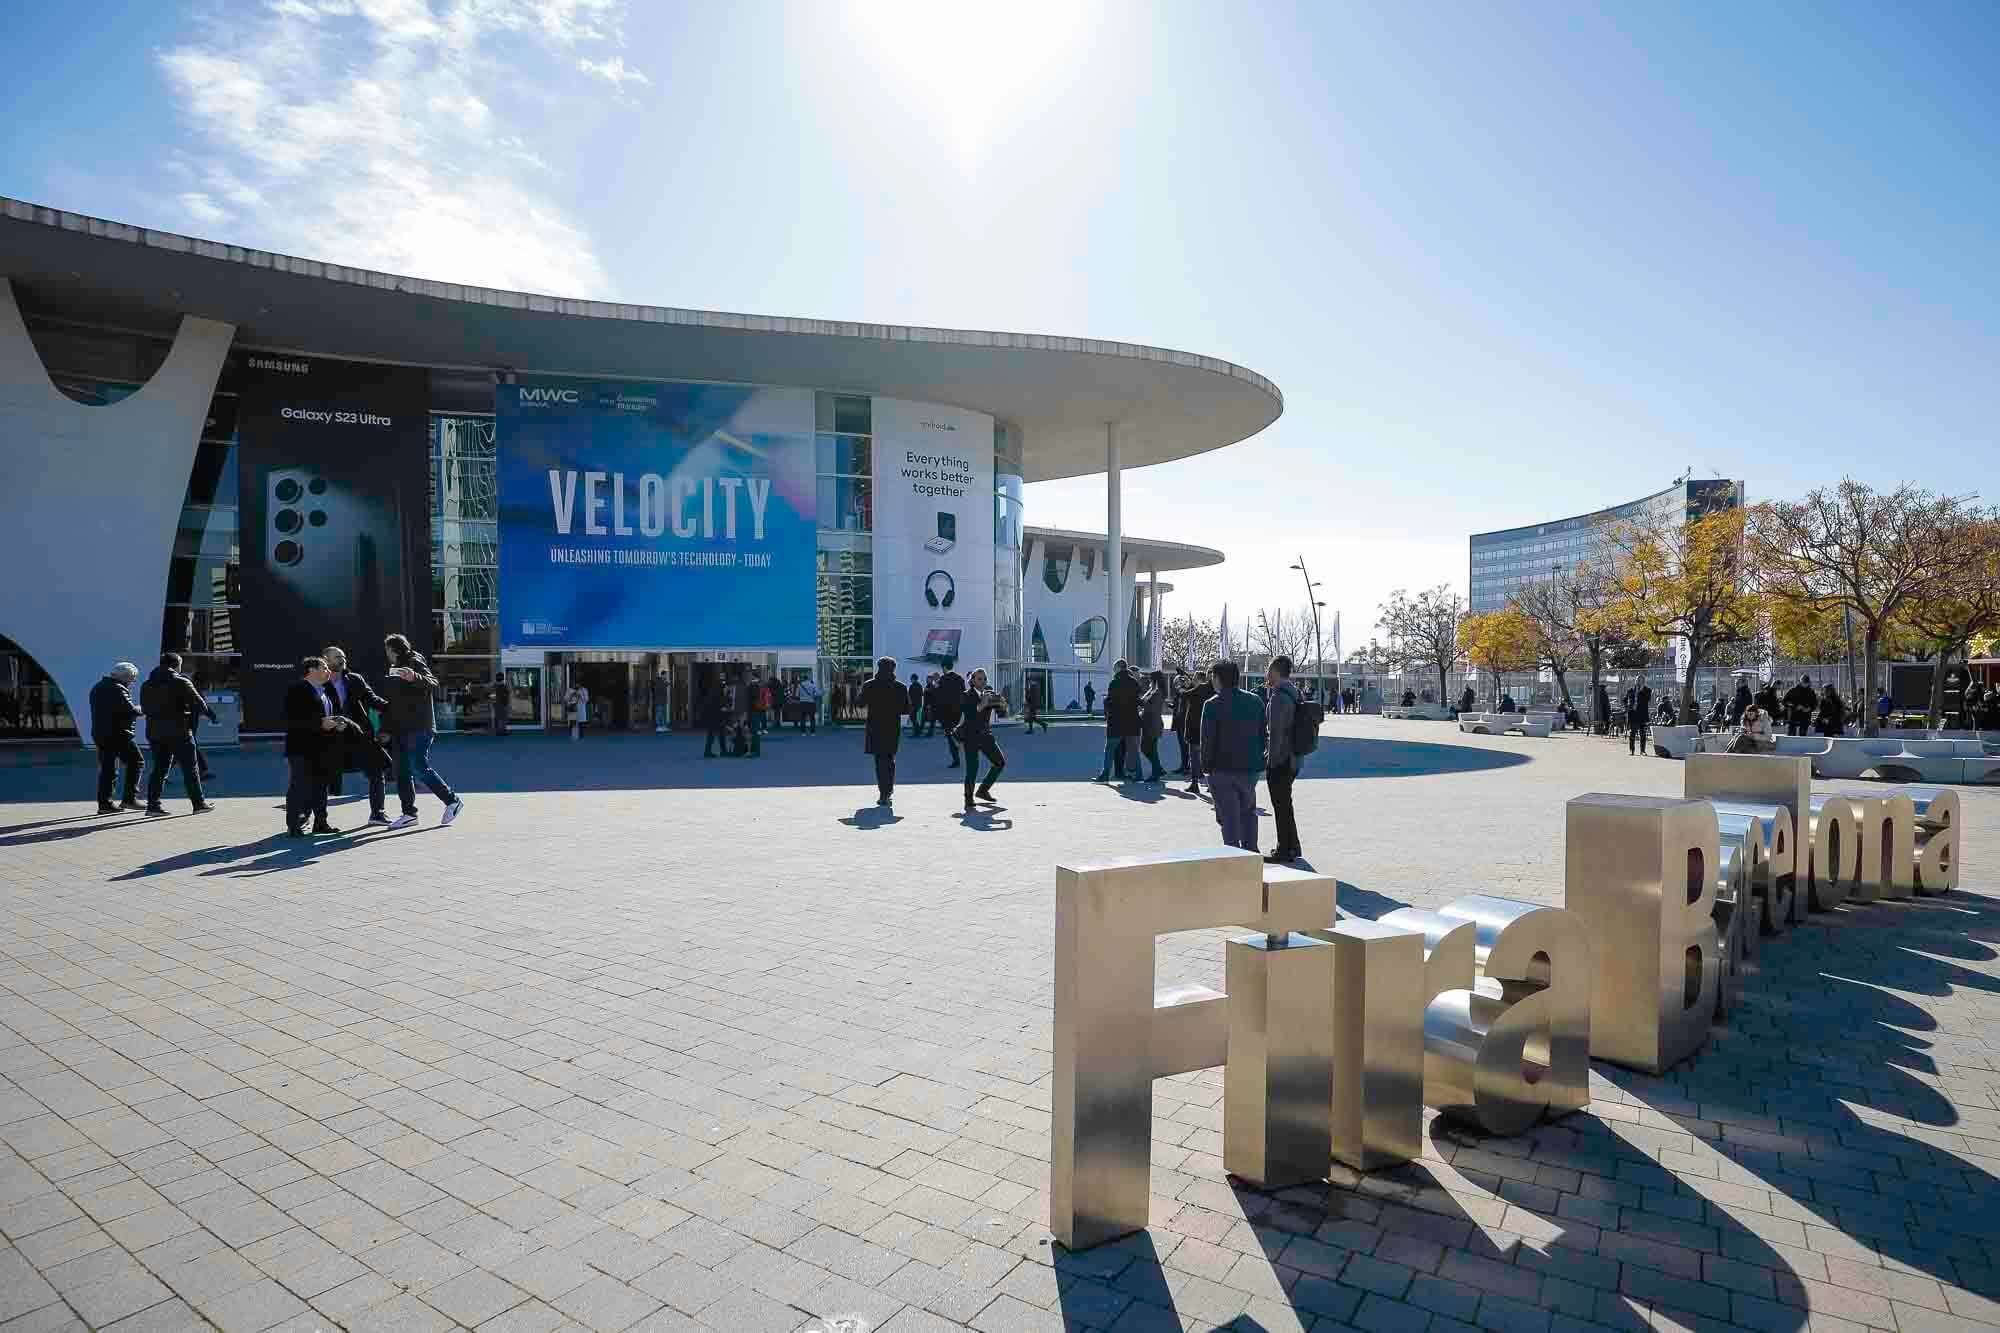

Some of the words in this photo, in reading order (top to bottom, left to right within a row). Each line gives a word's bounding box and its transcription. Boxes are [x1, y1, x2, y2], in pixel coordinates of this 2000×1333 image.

[248, 358, 309, 374] SAMSUNG
[519, 387, 579, 403] MWC
[281, 407, 332, 424] Galaxy
[335, 412, 357, 423] S23
[359, 413, 392, 426] Ultra
[906, 451, 969, 472] Everything
[901, 468, 938, 480] works
[941, 470, 975, 485] better
[912, 483, 965, 497] together
[549, 470, 770, 540] VELOCITY
[551, 548, 611, 564] UNLEASHING
[613, 550, 677, 566] TOMORROW'S
[679, 551, 737, 567] TECHNOLOGY
[743, 553, 772, 568] TODAY
[1051, 846, 1589, 1253] Fira
[1565, 752, 1960, 1076] Bcelona
